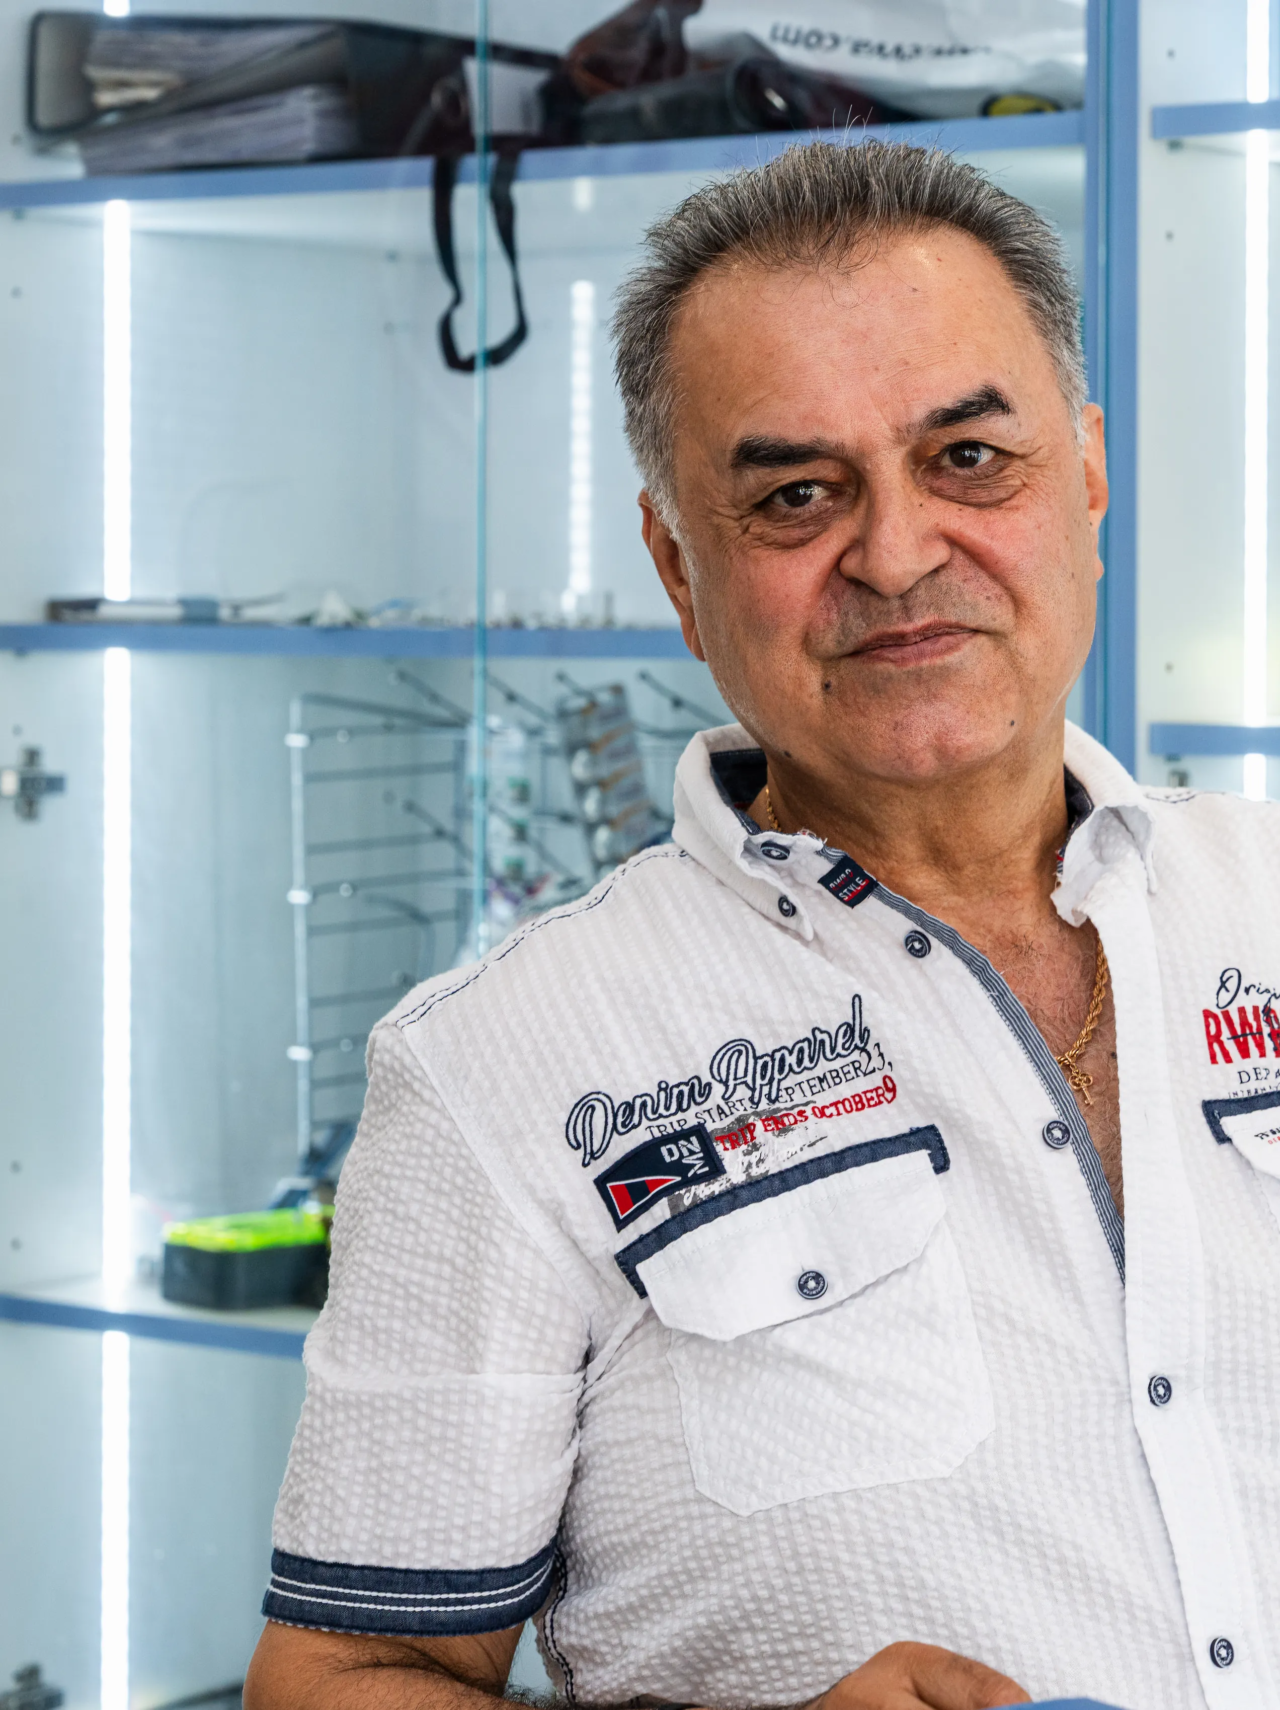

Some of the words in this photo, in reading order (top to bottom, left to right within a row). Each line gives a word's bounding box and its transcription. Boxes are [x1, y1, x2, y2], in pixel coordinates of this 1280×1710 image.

[839, 876, 867, 902] STYLE
[565, 1075, 712, 1168] Denim
[709, 993, 871, 1108] Apparel
[644, 1118, 688, 1140] TRIP
[714, 1121, 757, 1152] TRIP
[760, 1109, 809, 1133] ENDS
